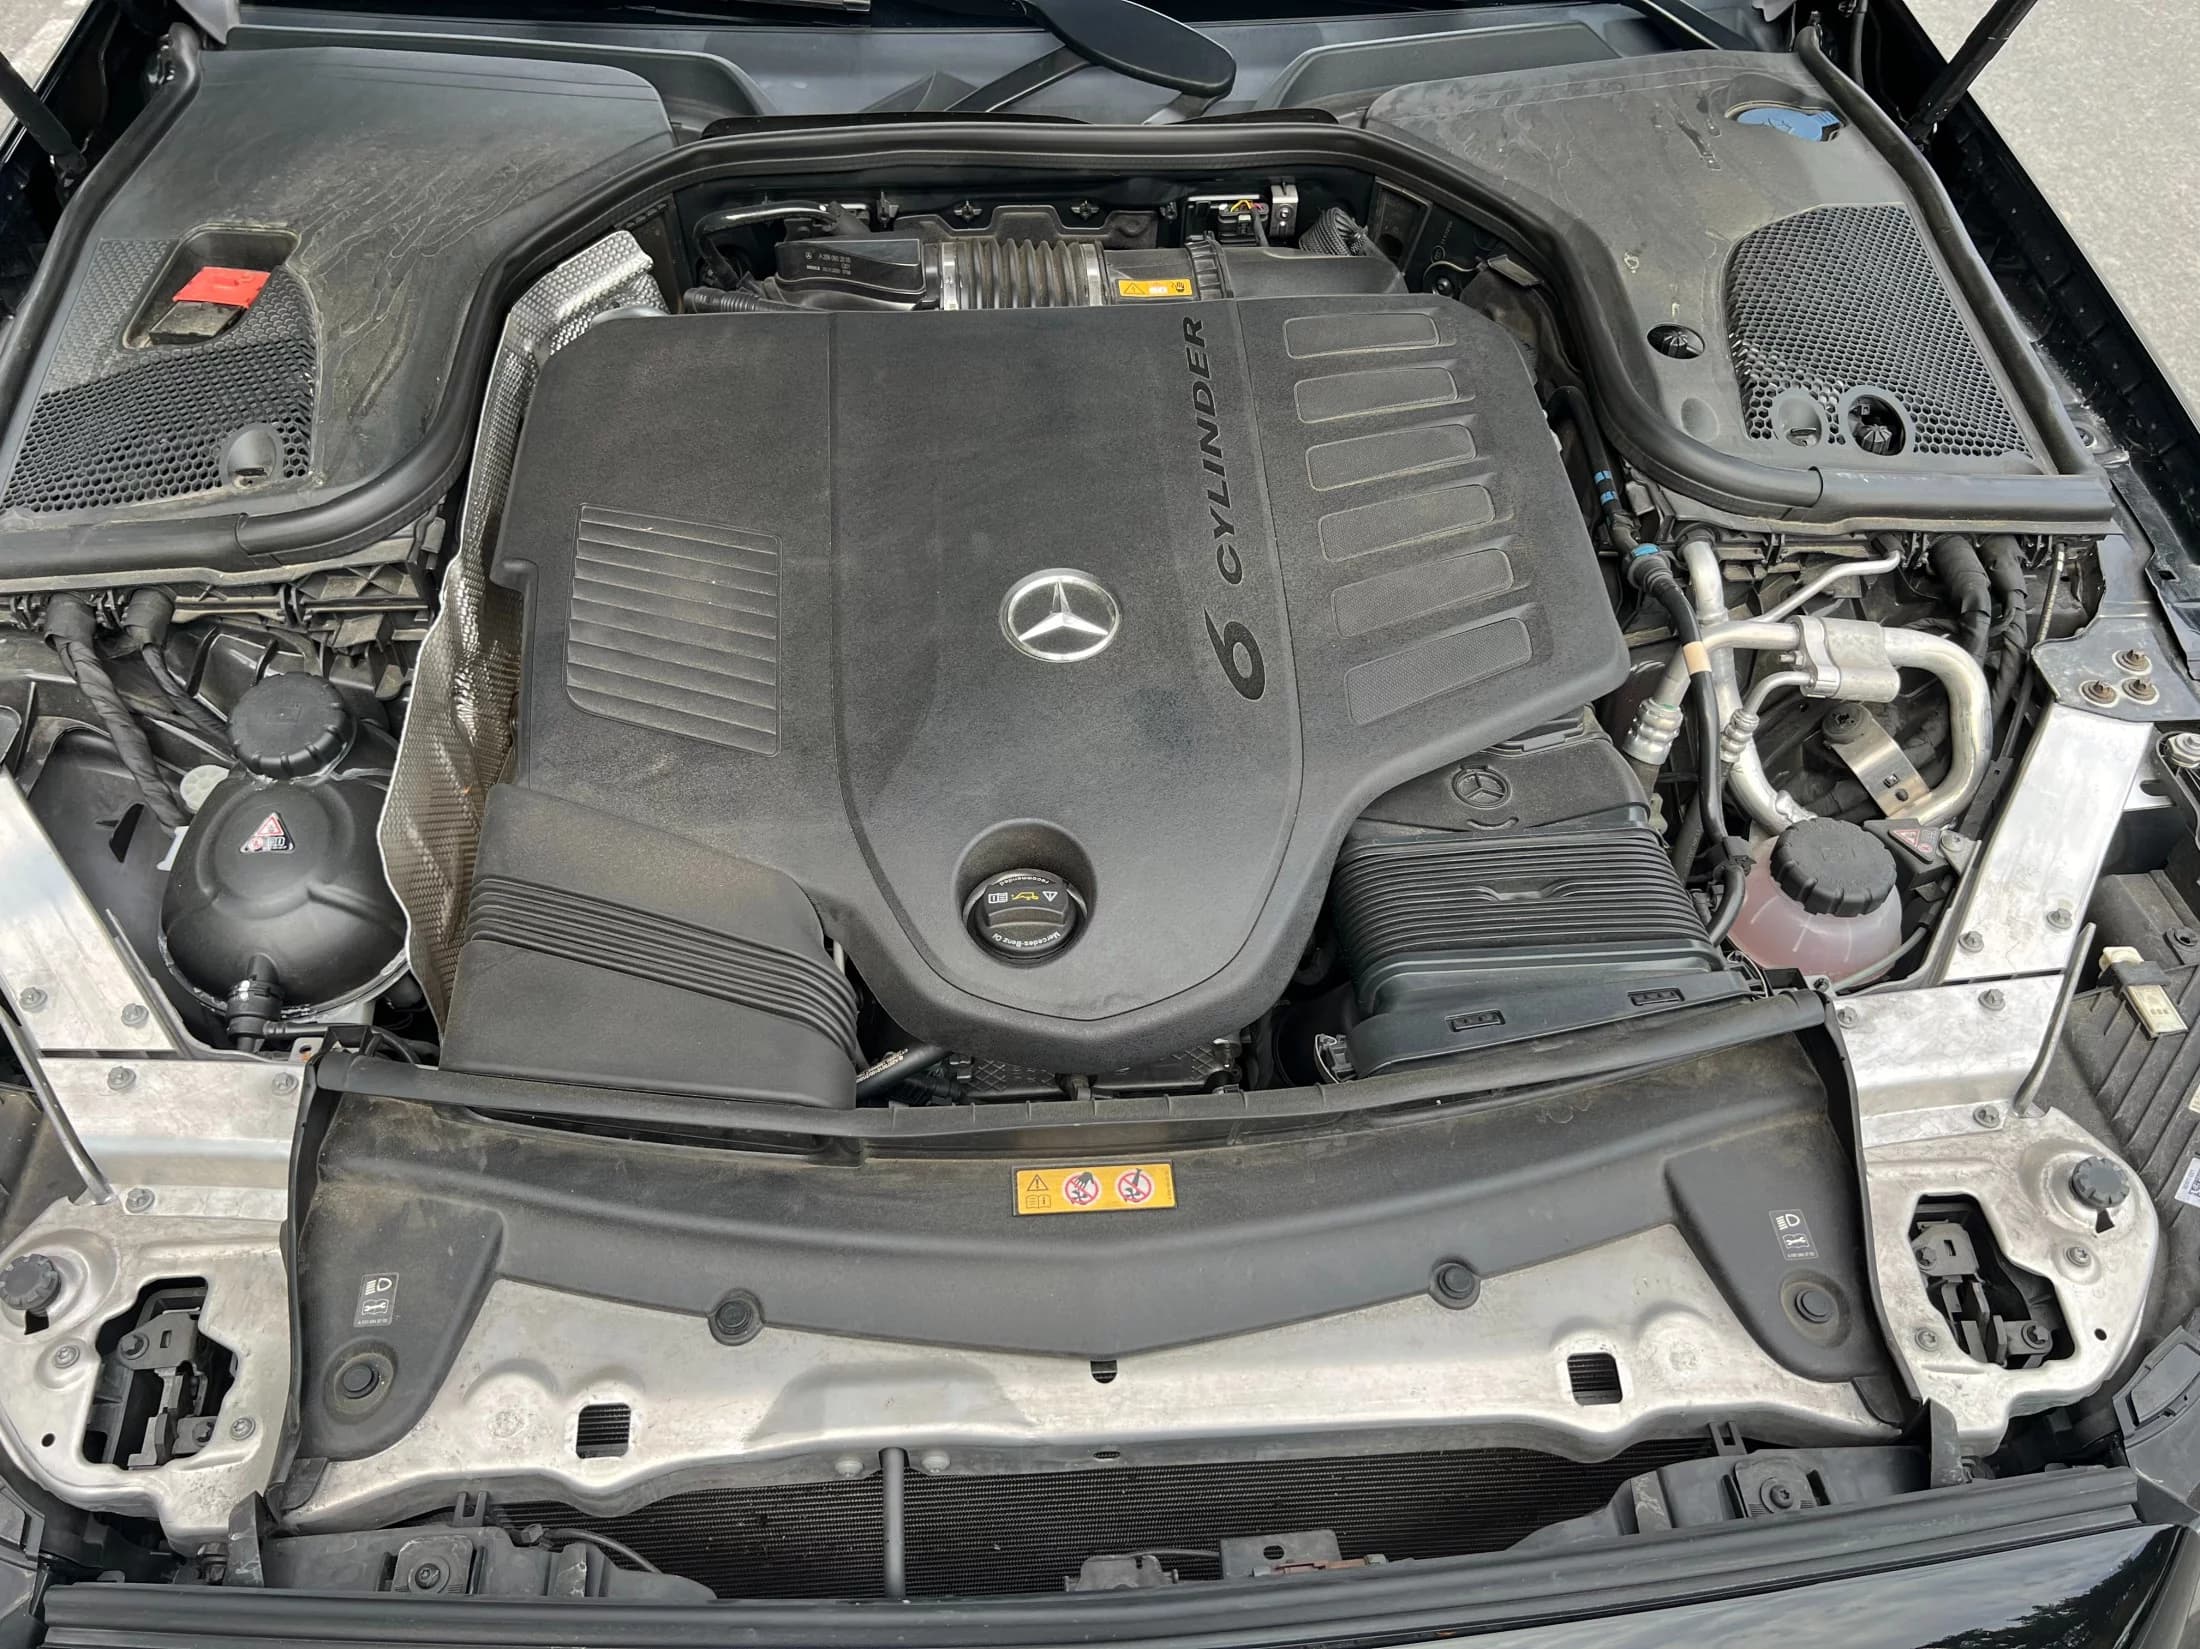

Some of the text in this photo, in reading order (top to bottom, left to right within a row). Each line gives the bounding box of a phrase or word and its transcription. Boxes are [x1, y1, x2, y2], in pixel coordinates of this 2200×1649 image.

[1183, 316, 1266, 701] 6 CYLINDER
[1003, 931, 1061, 948] Mercedes-Benz
